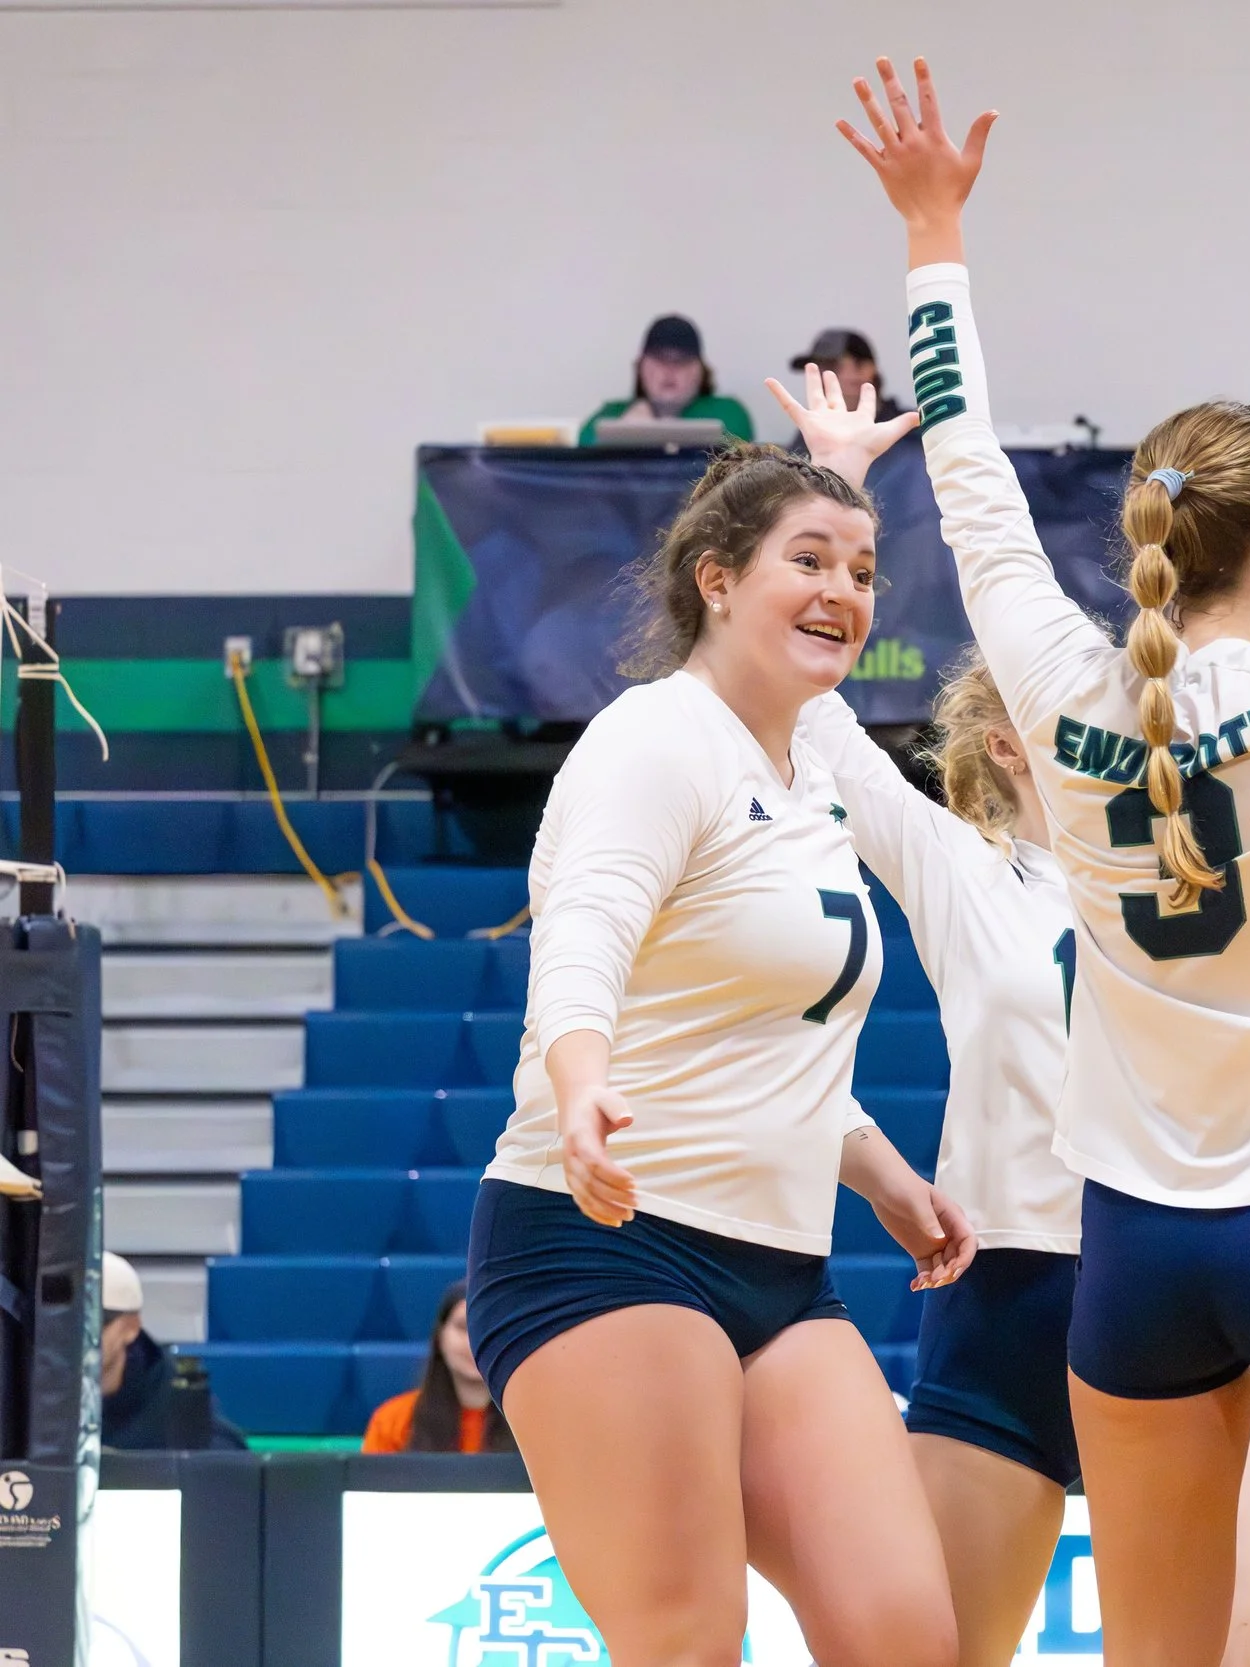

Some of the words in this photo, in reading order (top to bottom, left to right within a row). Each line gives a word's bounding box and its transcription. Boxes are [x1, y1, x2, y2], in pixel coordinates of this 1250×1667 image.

[849, 639, 925, 680] ulls
[1105, 771, 1248, 961] 3
[802, 887, 868, 1025] 7
